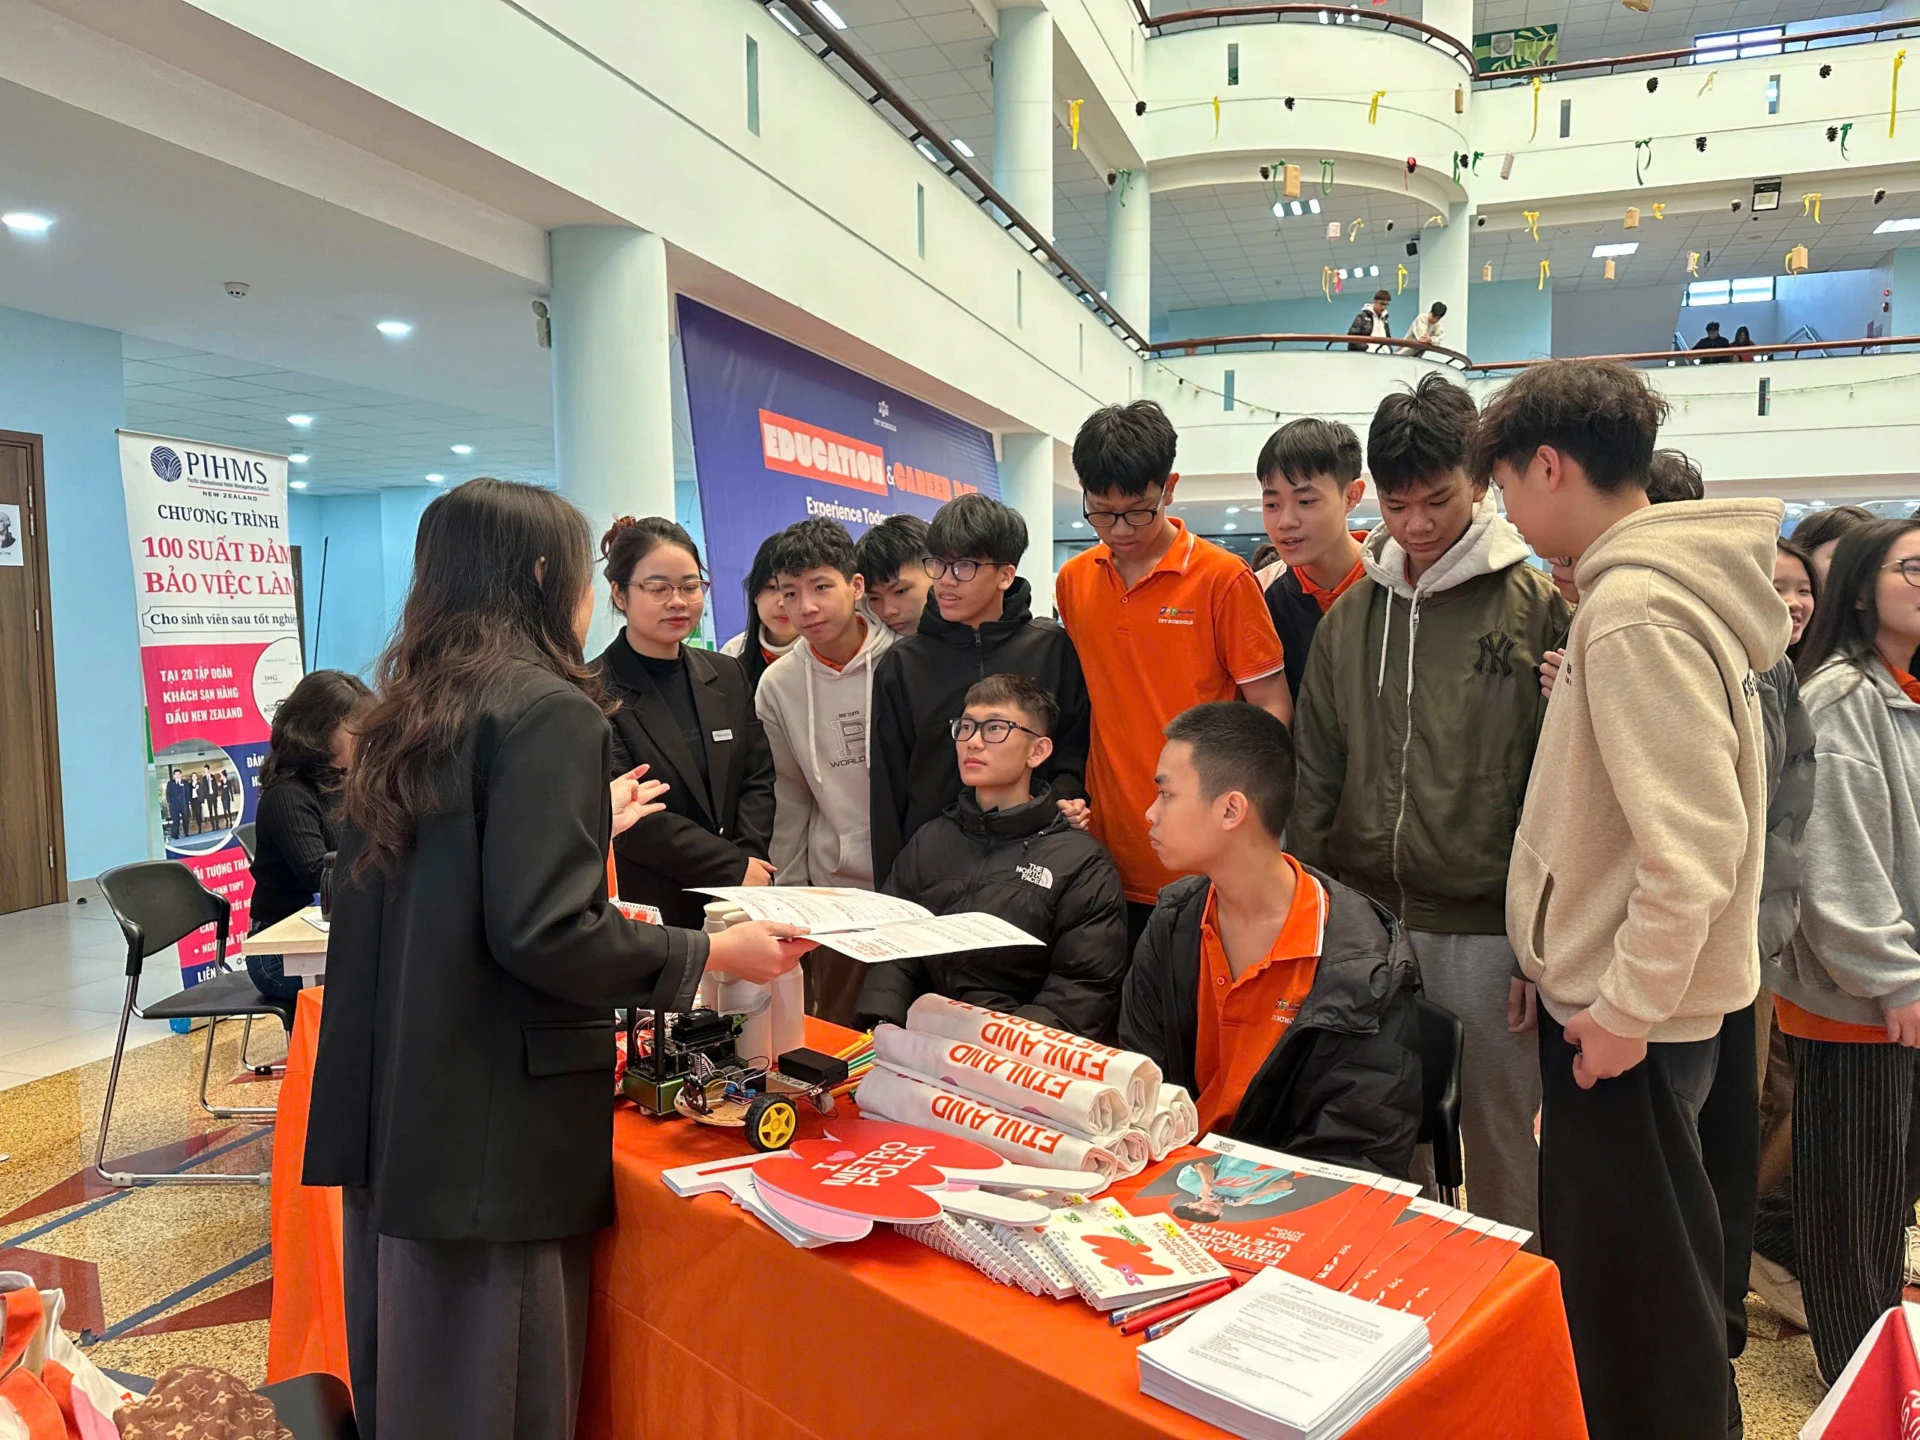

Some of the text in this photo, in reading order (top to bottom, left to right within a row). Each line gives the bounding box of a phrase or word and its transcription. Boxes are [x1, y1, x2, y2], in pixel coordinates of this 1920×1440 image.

[184, 451, 267, 485] PIHMS
[763, 422, 885, 486] EDUCATION
[886, 465, 895, 486] &
[894, 462, 952, 503] CAREER
[202, 490, 258, 502] NEW ZEALAND
[157, 504, 280, 529] CHƯƠNG TRÌNH
[806, 496, 863, 523] Experience
[142, 536, 184, 559] 100
[188, 535, 244, 562] SUẤT
[143, 565, 198, 594] BẢO
[201, 569, 252, 600] VIỆC
[150, 613, 179, 625] Cho
[181, 613, 204, 625] sinh
[206, 613, 229, 625] viên
[231, 616, 251, 625] sau
[254, 612, 270, 625] tốt
[1474, 630, 1515, 678] NY
[160, 664, 233, 684] TẠI 20 TẬP ĐOÀN
[163, 685, 239, 703] KHÁCH SẠN HÀNG
[191, 709, 208, 722] NEW
[209, 706, 243, 720] ZEALAND
[830, 755, 867, 768] WORLD
[205, 862, 233, 879] TƯỢNG
[233, 858, 251, 871] THA
[1015, 865, 1042, 879] NORTH
[1021, 873, 1041, 885] FACE
[1029, 862, 1043, 873] THE
[228, 880, 244, 892] THPT
[197, 965, 217, 983] LIÊN
[981, 1022, 1109, 1082] FINLAND
[949, 1044, 1073, 1100] FINLAND
[931, 1095, 1064, 1155] FINLAND
[820, 1141, 908, 1188] METRO
[854, 1145, 937, 1188] POLIA
[1184, 1230, 1287, 1259] METROPO
[1190, 1223, 1291, 1252] VIETNAM
[1158, 1238, 1199, 1275] FINLAND
[1195, 1240, 1280, 1266] FINLAN
